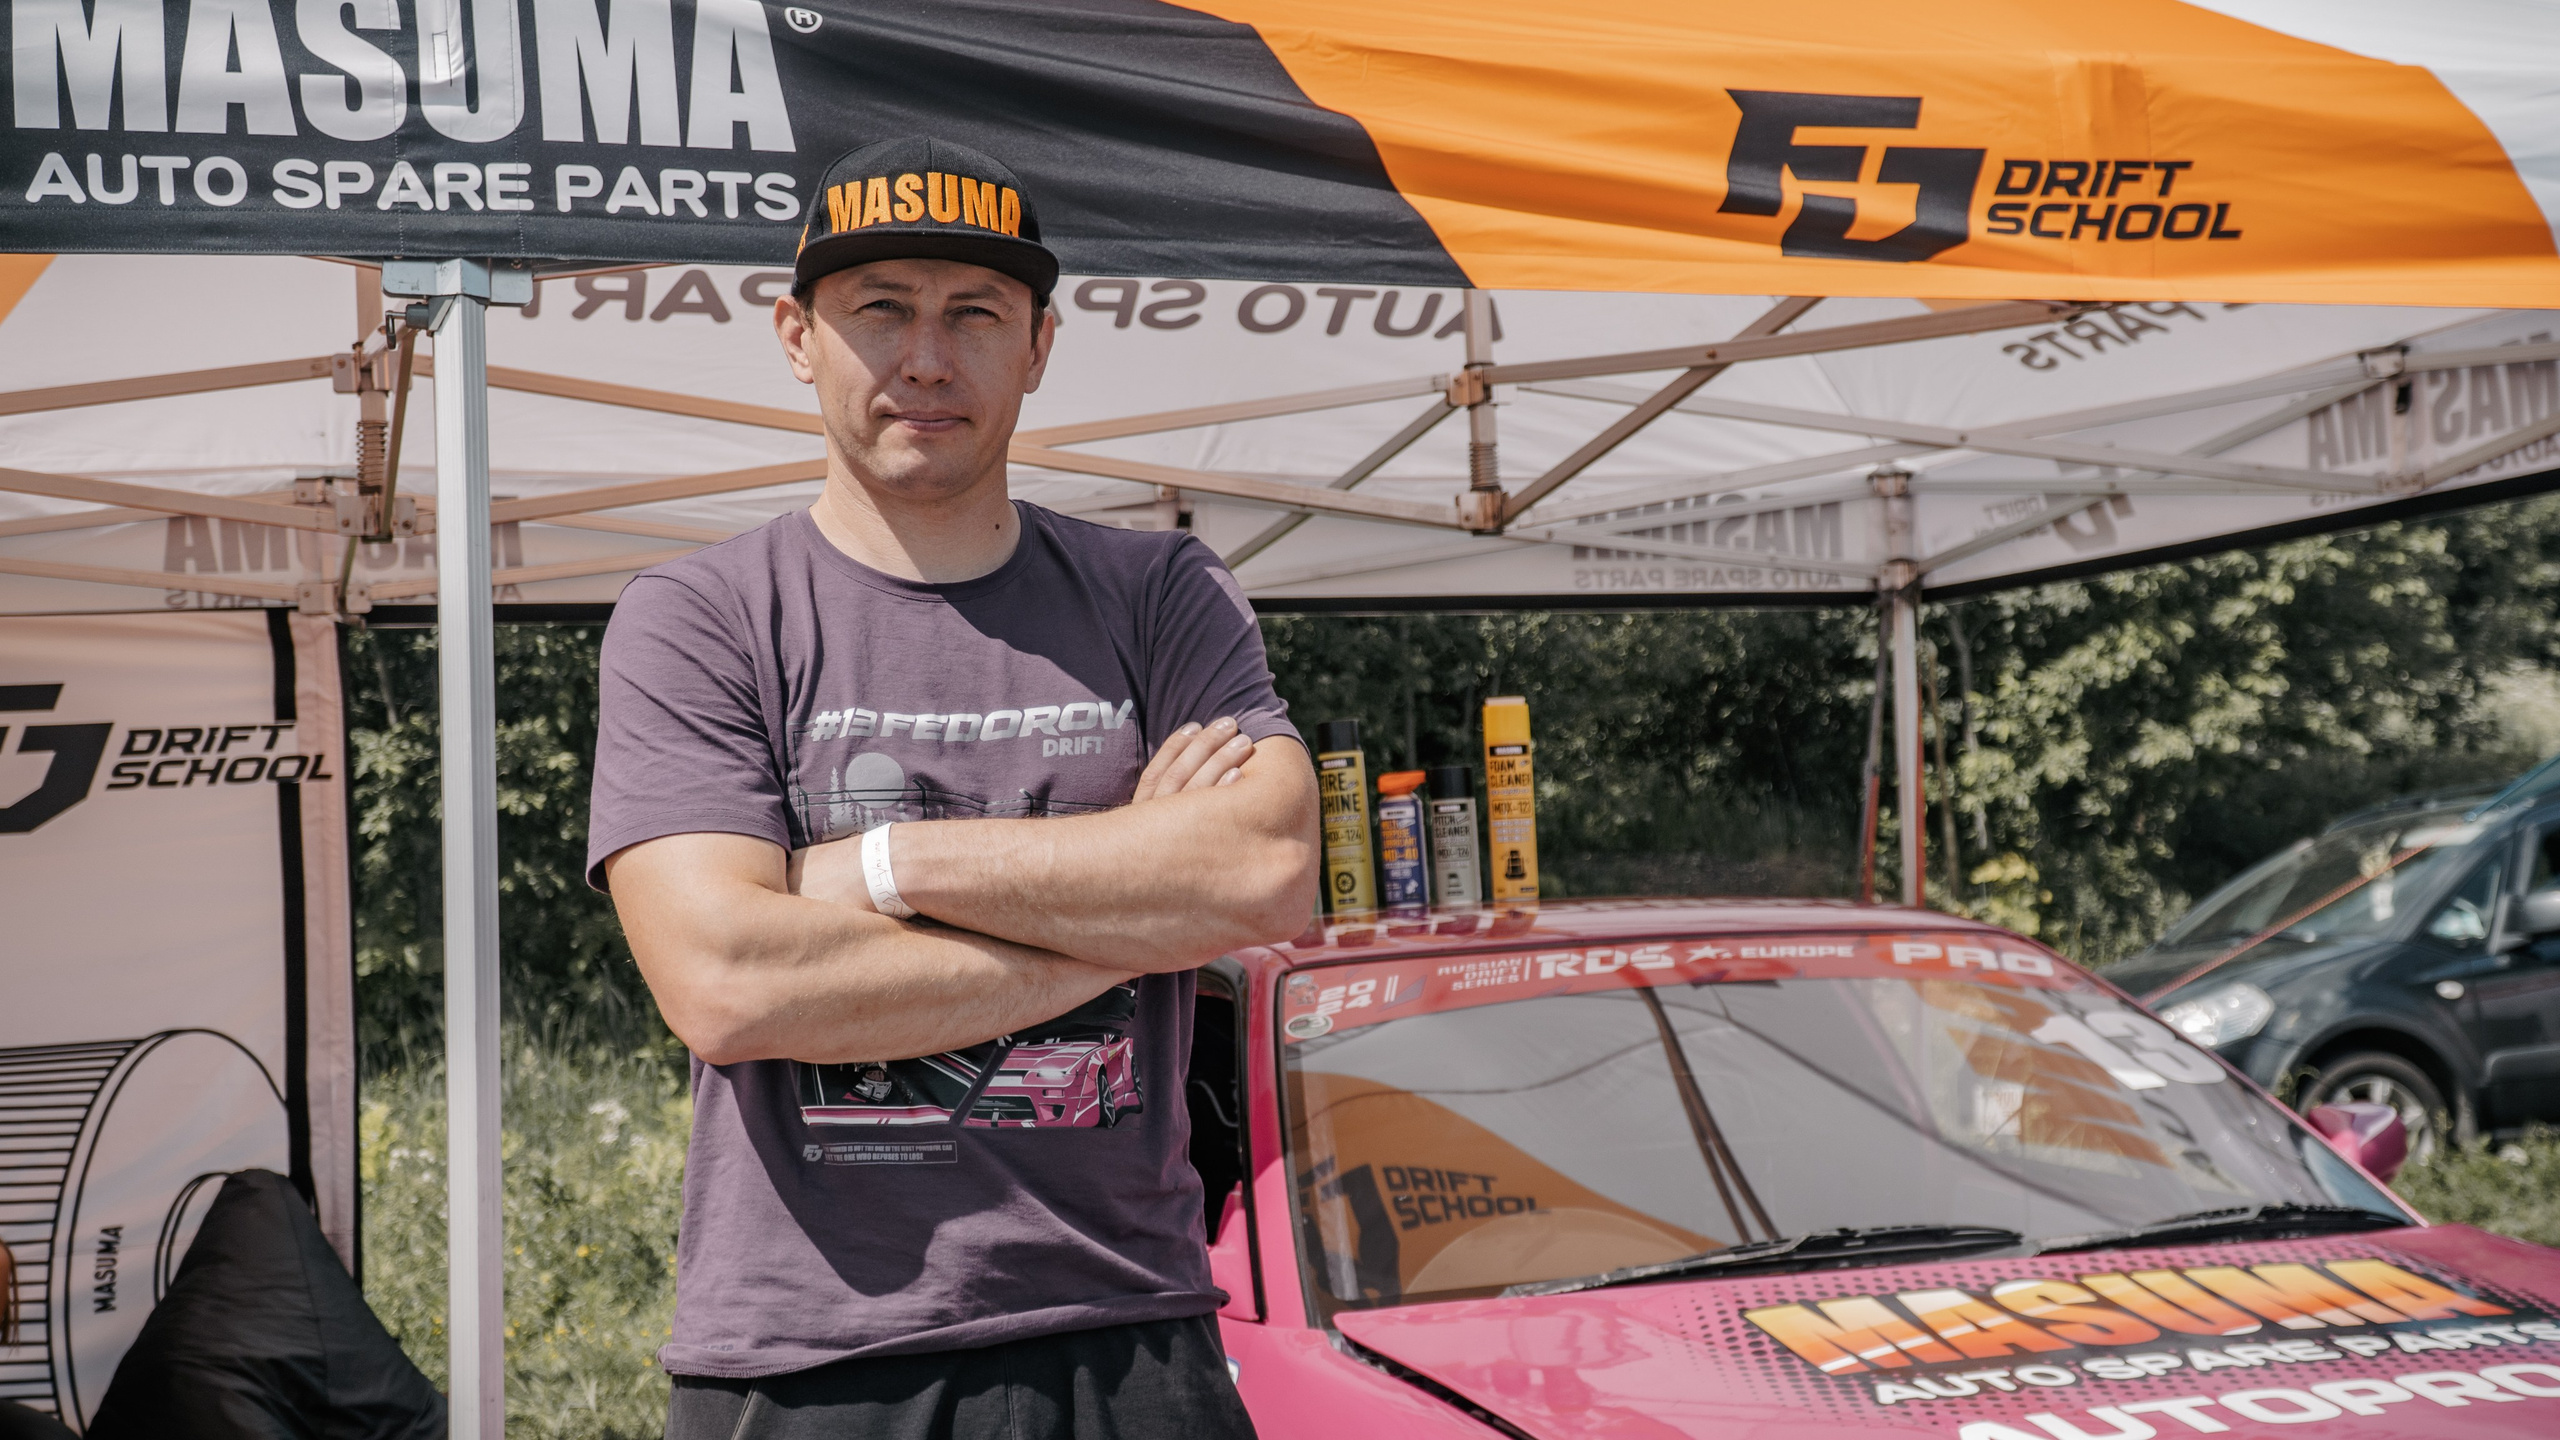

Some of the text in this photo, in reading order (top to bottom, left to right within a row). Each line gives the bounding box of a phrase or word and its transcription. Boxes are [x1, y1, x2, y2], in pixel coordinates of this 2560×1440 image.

[13, 0, 797, 153] MASUMA
[25, 151, 800, 222] AUTO SPARE PARTS
[1994, 159, 2194, 197] DRIFT
[827, 171, 1021, 238] MASUMA
[1986, 202, 2243, 242] SCHOOL
[120, 724, 296, 757] DRIFT
[1043, 736, 1104, 757] DRIFT
[105, 754, 333, 791] SCHOOL
[1489, 760, 1516, 773] FOAM
[1490, 773, 1532, 789] CLEANER
[1437, 957, 1522, 976] RUSSIAN
[1464, 966, 1518, 981] DRIFT
[1536, 942, 2054, 979] RDS EUROPE PRO
[1452, 975, 1519, 991] SERIES
[900, 1152, 908, 1160] TO
[909, 1152, 923, 1160] LOSE
[94, 1224, 124, 1314] MASUMA
[1743, 1258, 2513, 1375] MASUMA
[1874, 1364, 2076, 1405] AUTO
[2082, 1337, 2343, 1380] SPARE
